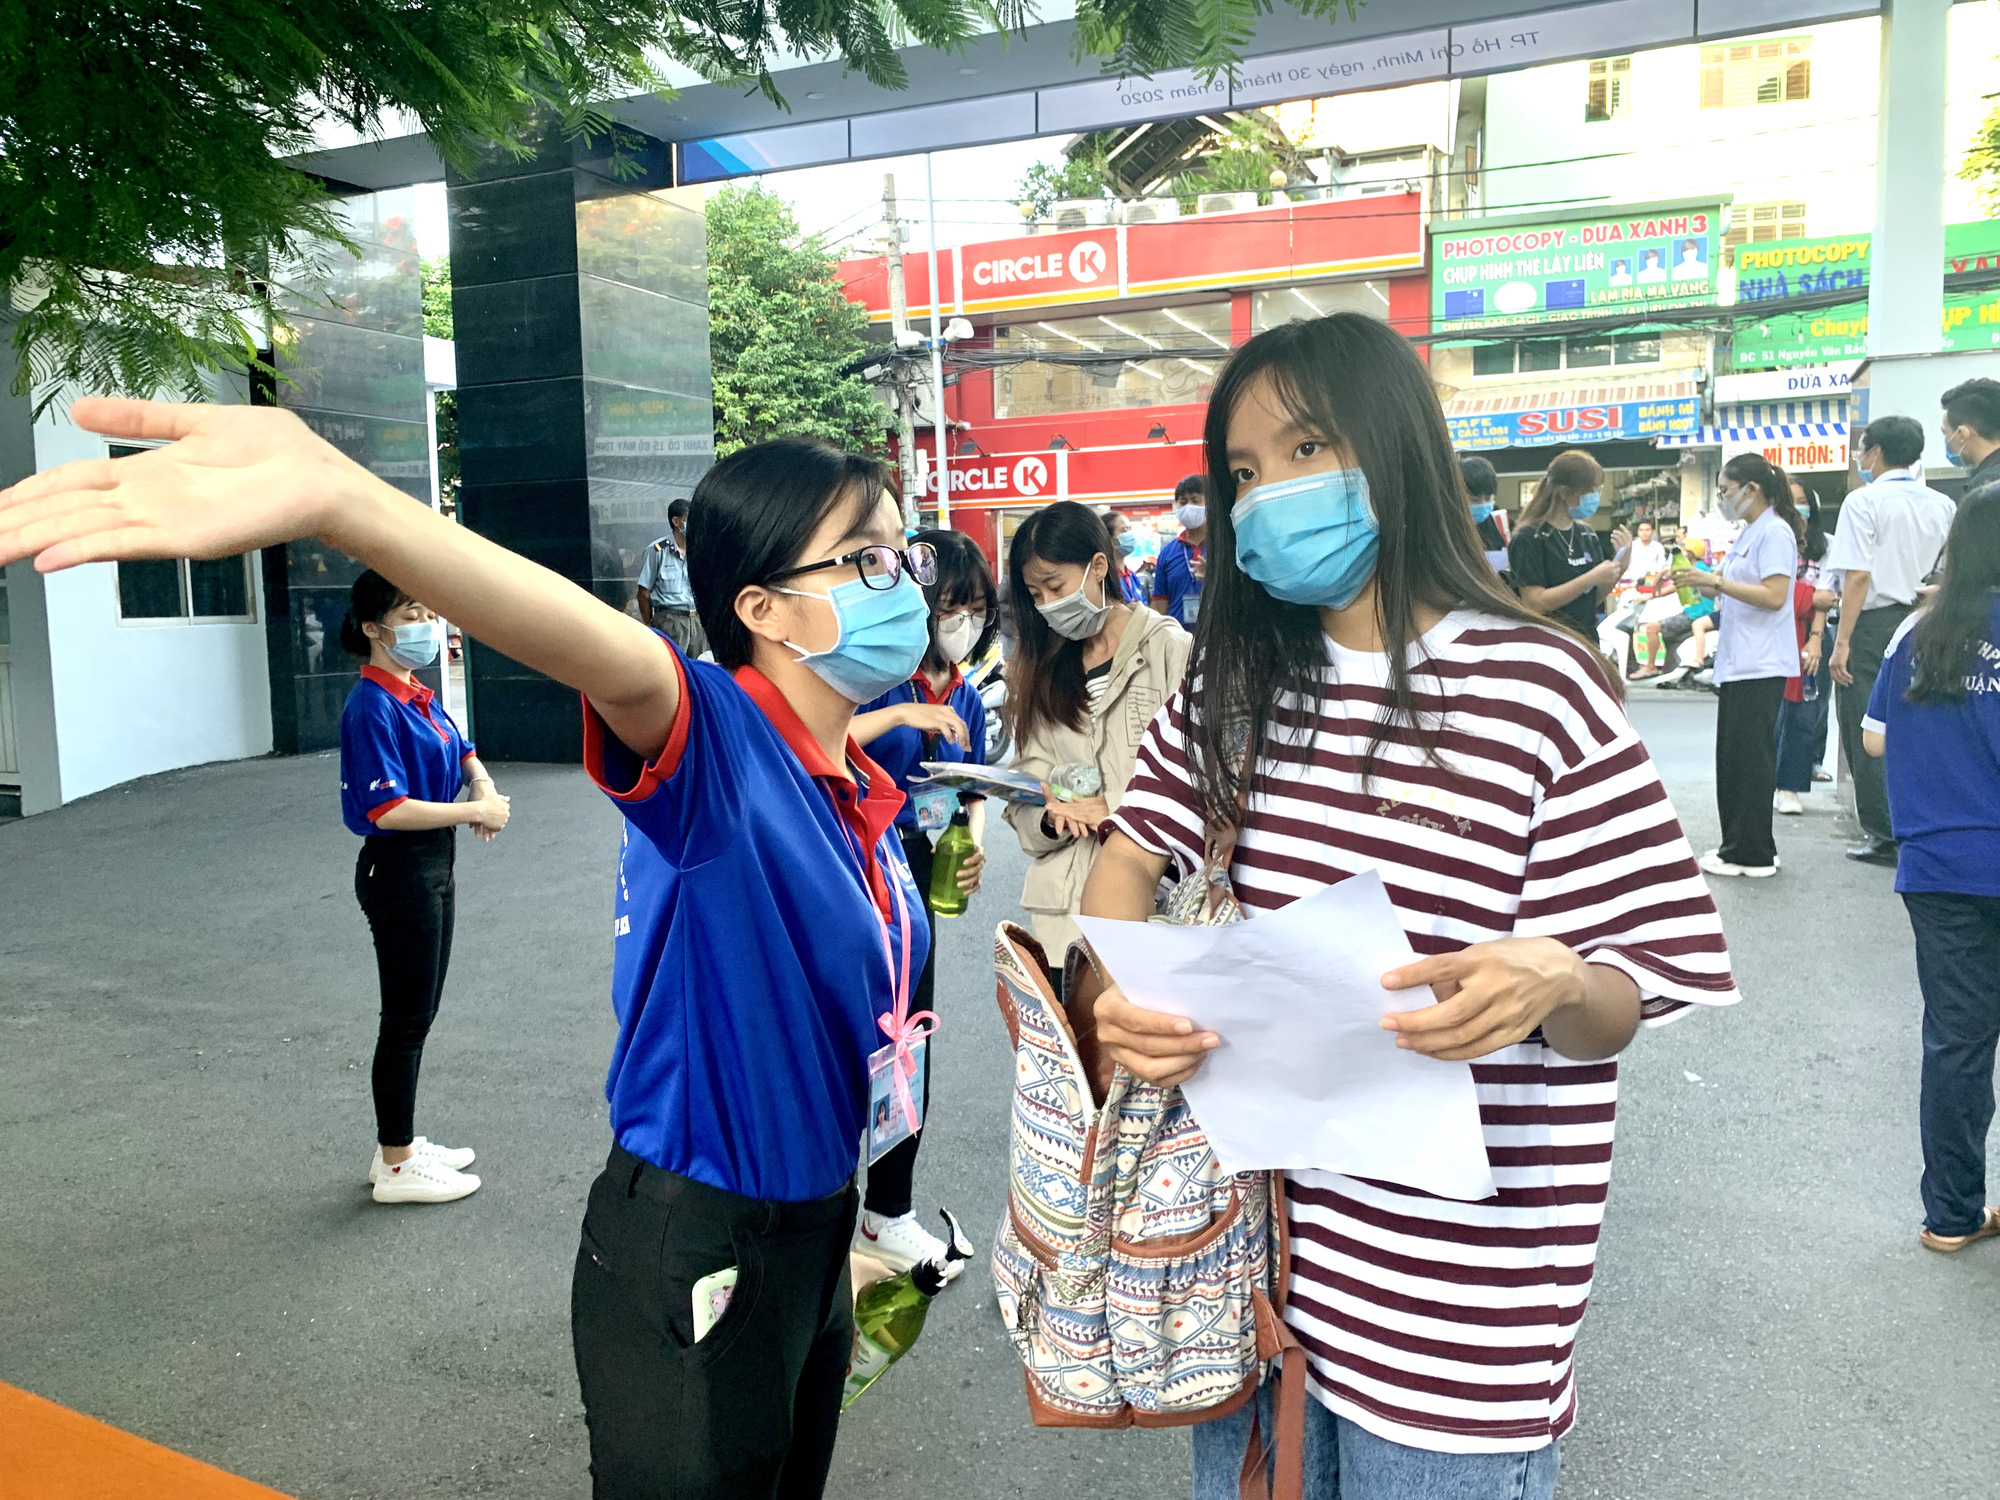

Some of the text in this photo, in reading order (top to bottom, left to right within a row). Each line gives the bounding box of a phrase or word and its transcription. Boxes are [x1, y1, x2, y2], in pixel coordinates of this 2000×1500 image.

[1442, 230, 1566, 259] PHOTOCOPY
[1627, 217, 1688, 241] XANH
[1690, 213, 1709, 234] 3
[973, 244, 1107, 286] CIRCLE K
[1741, 240, 1871, 271] PHOTOCOPY
[1739, 265, 1864, 302] NHÀ SÁCH
[1762, 350, 1775, 361] 51
[1517, 404, 1623, 435] SUSI
[1788, 441, 1834, 470] TRỘN:
[927, 460, 1048, 495] CIRCLE K
